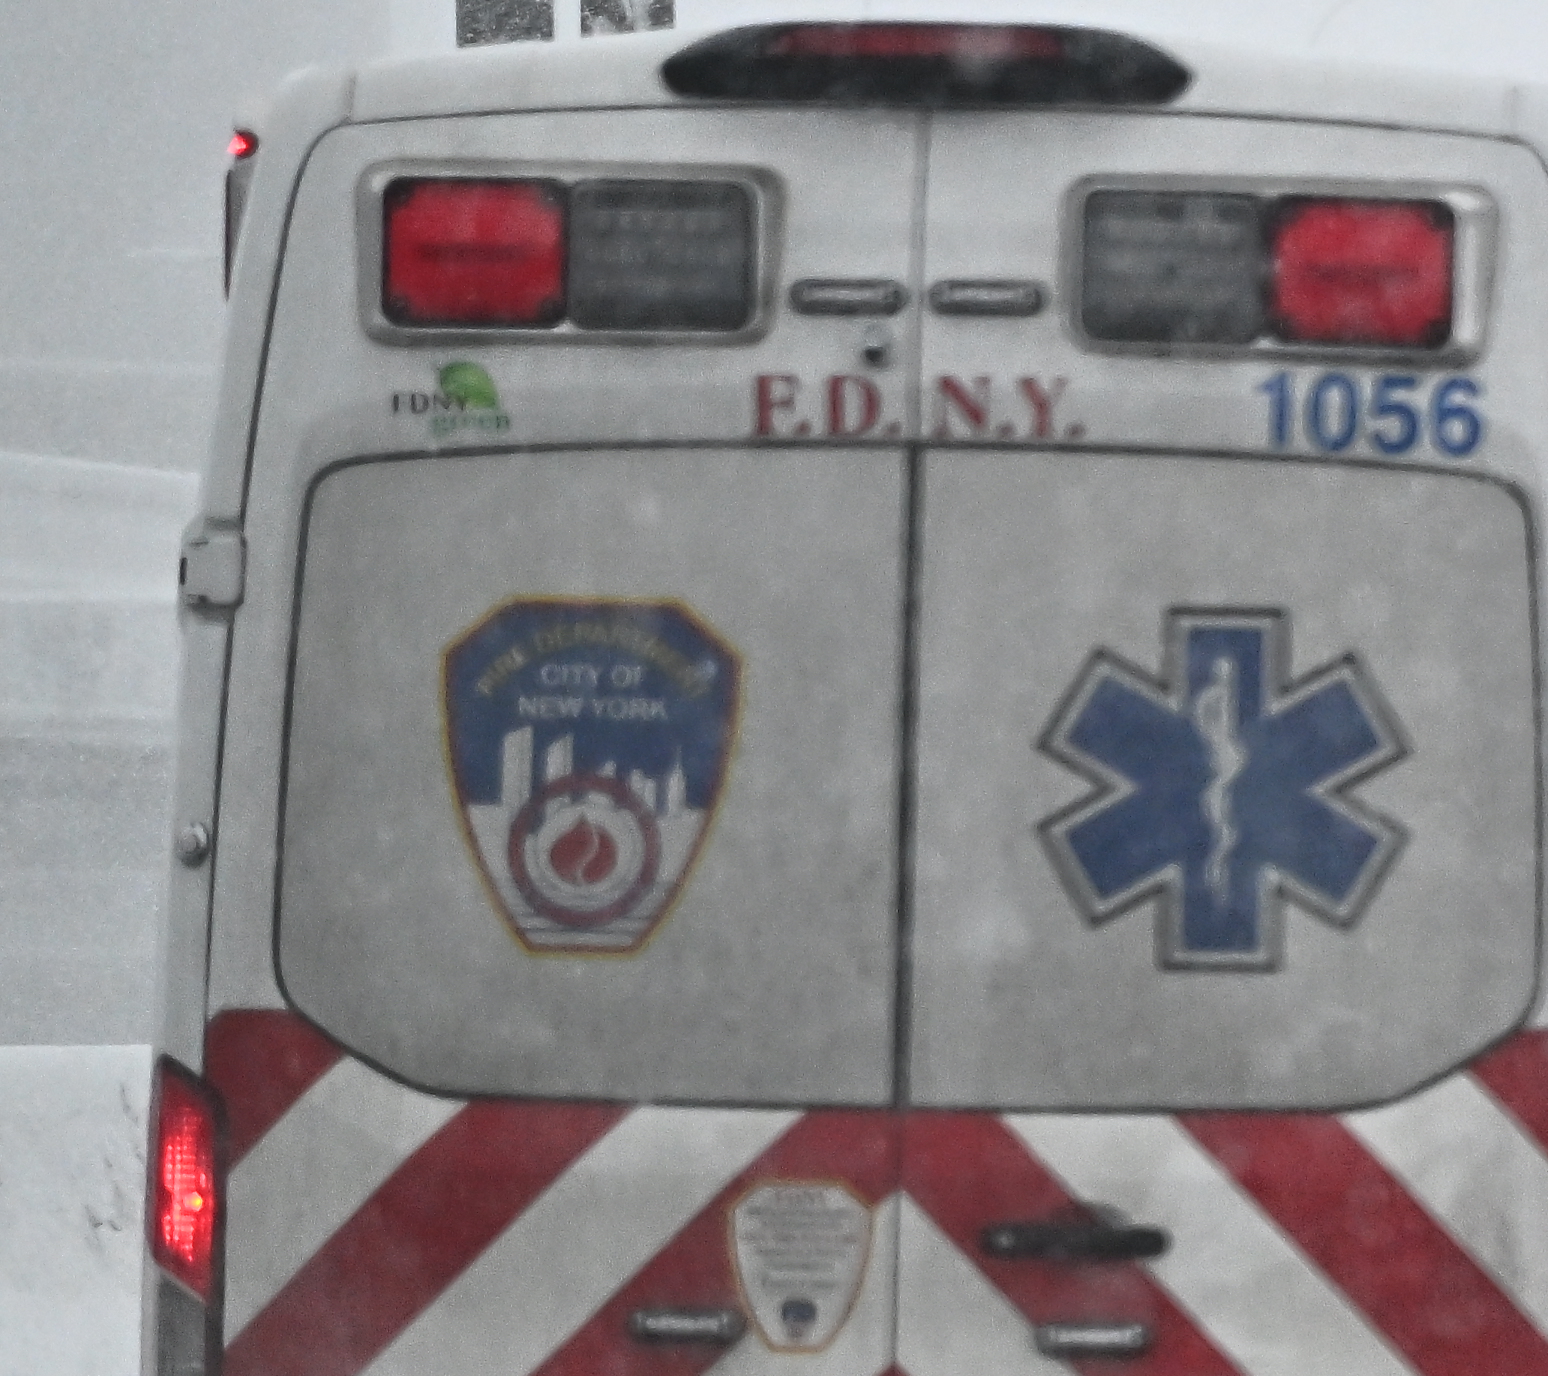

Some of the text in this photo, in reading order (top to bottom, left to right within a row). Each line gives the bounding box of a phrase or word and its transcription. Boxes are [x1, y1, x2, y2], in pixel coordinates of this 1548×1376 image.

[1257, 370, 1484, 458] 1056
[539, 662, 600, 688] CITY
[518, 695, 668, 720] NEW YORK
